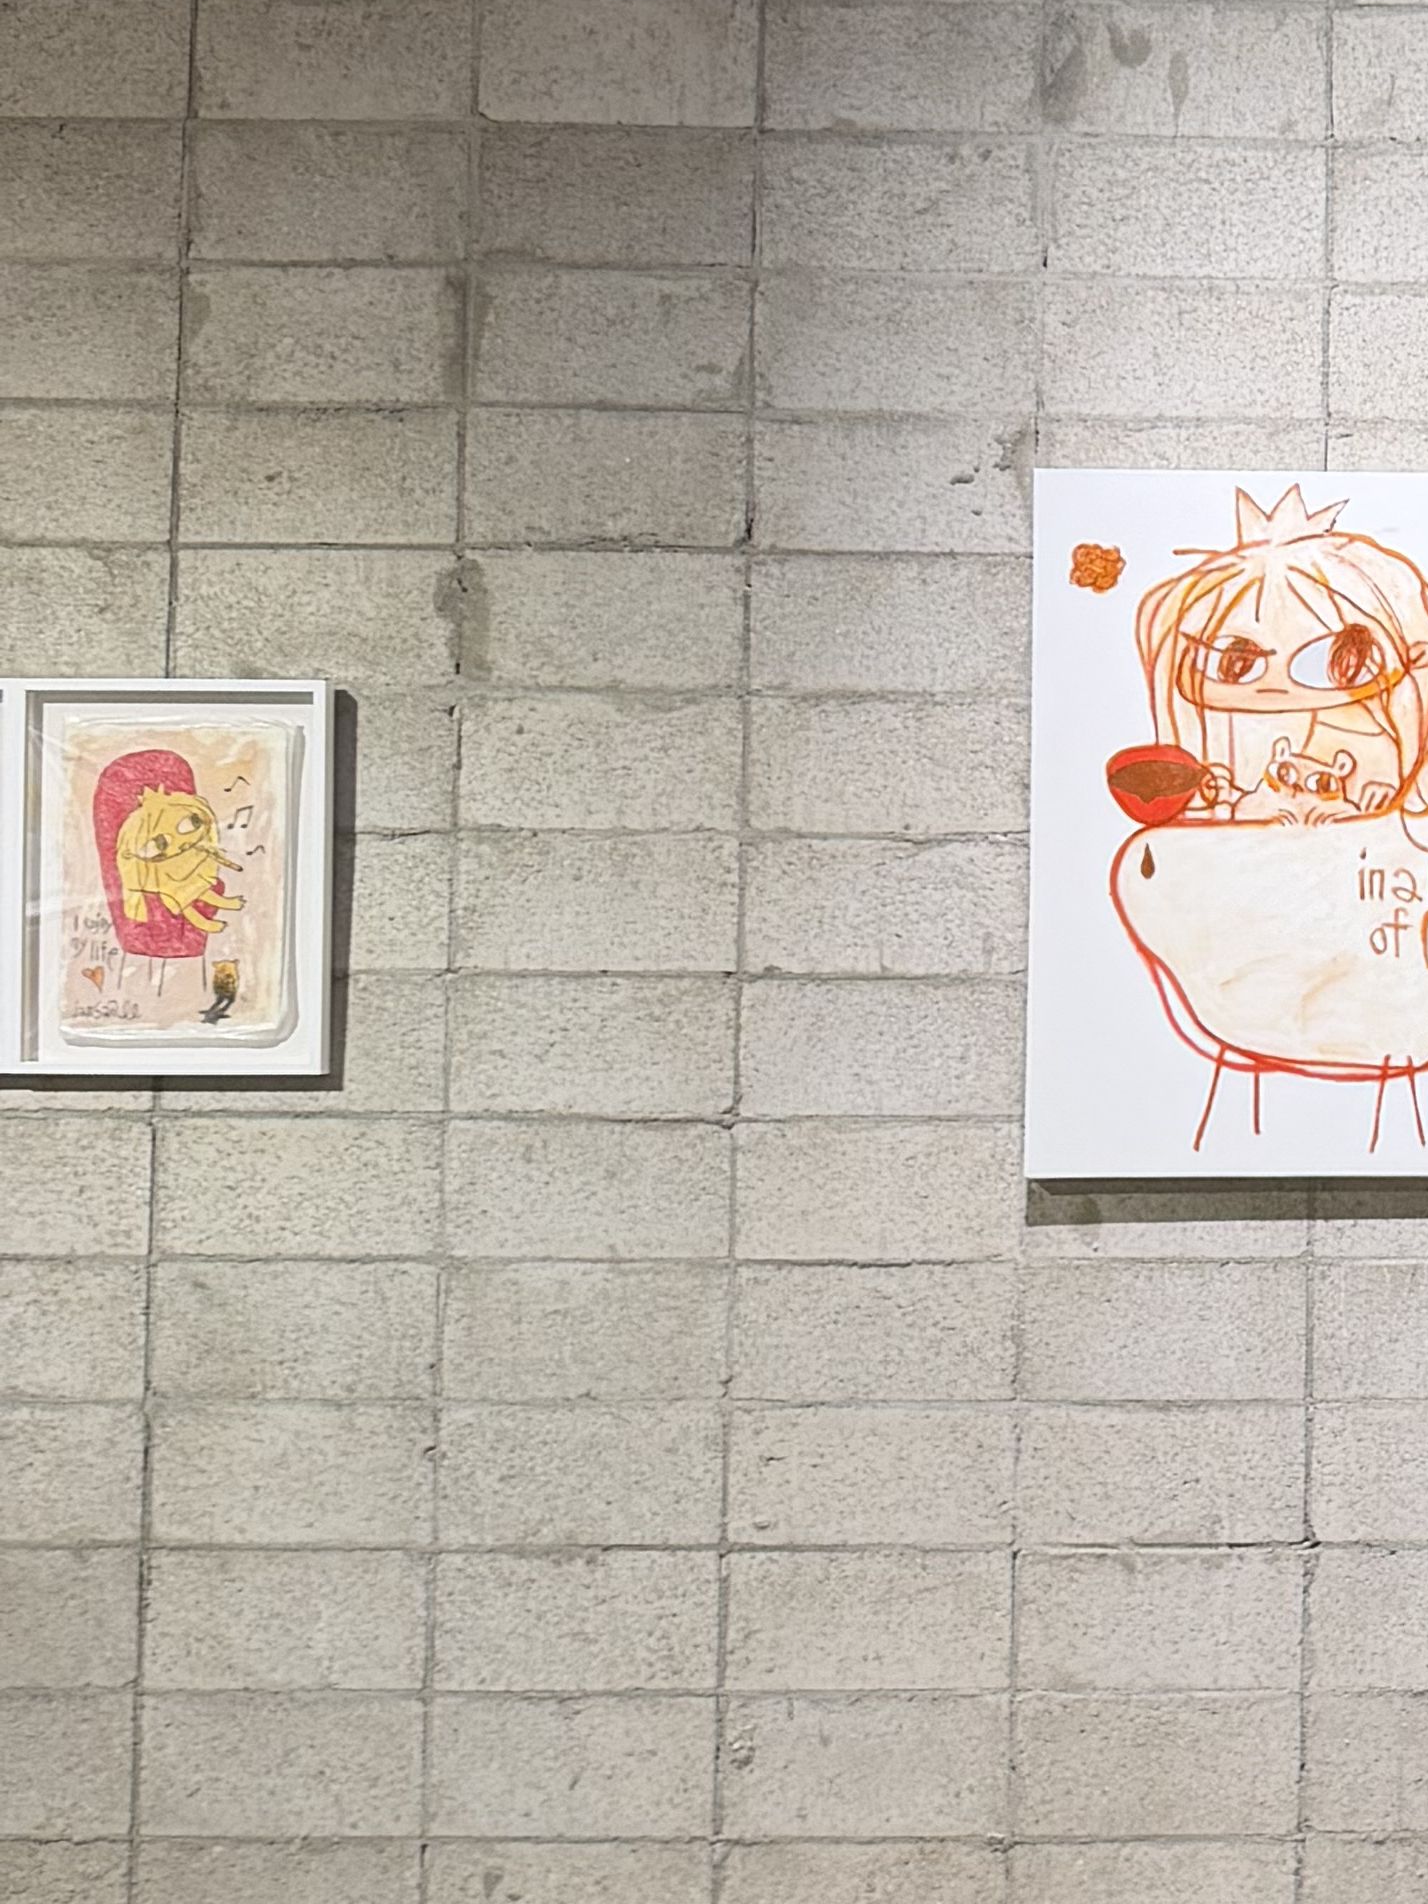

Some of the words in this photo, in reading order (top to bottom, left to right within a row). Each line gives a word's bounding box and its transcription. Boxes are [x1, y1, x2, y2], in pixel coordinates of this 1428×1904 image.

[1357, 847, 1385, 901] in
[1391, 868, 1423, 903] a
[1369, 907, 1413, 958] of
